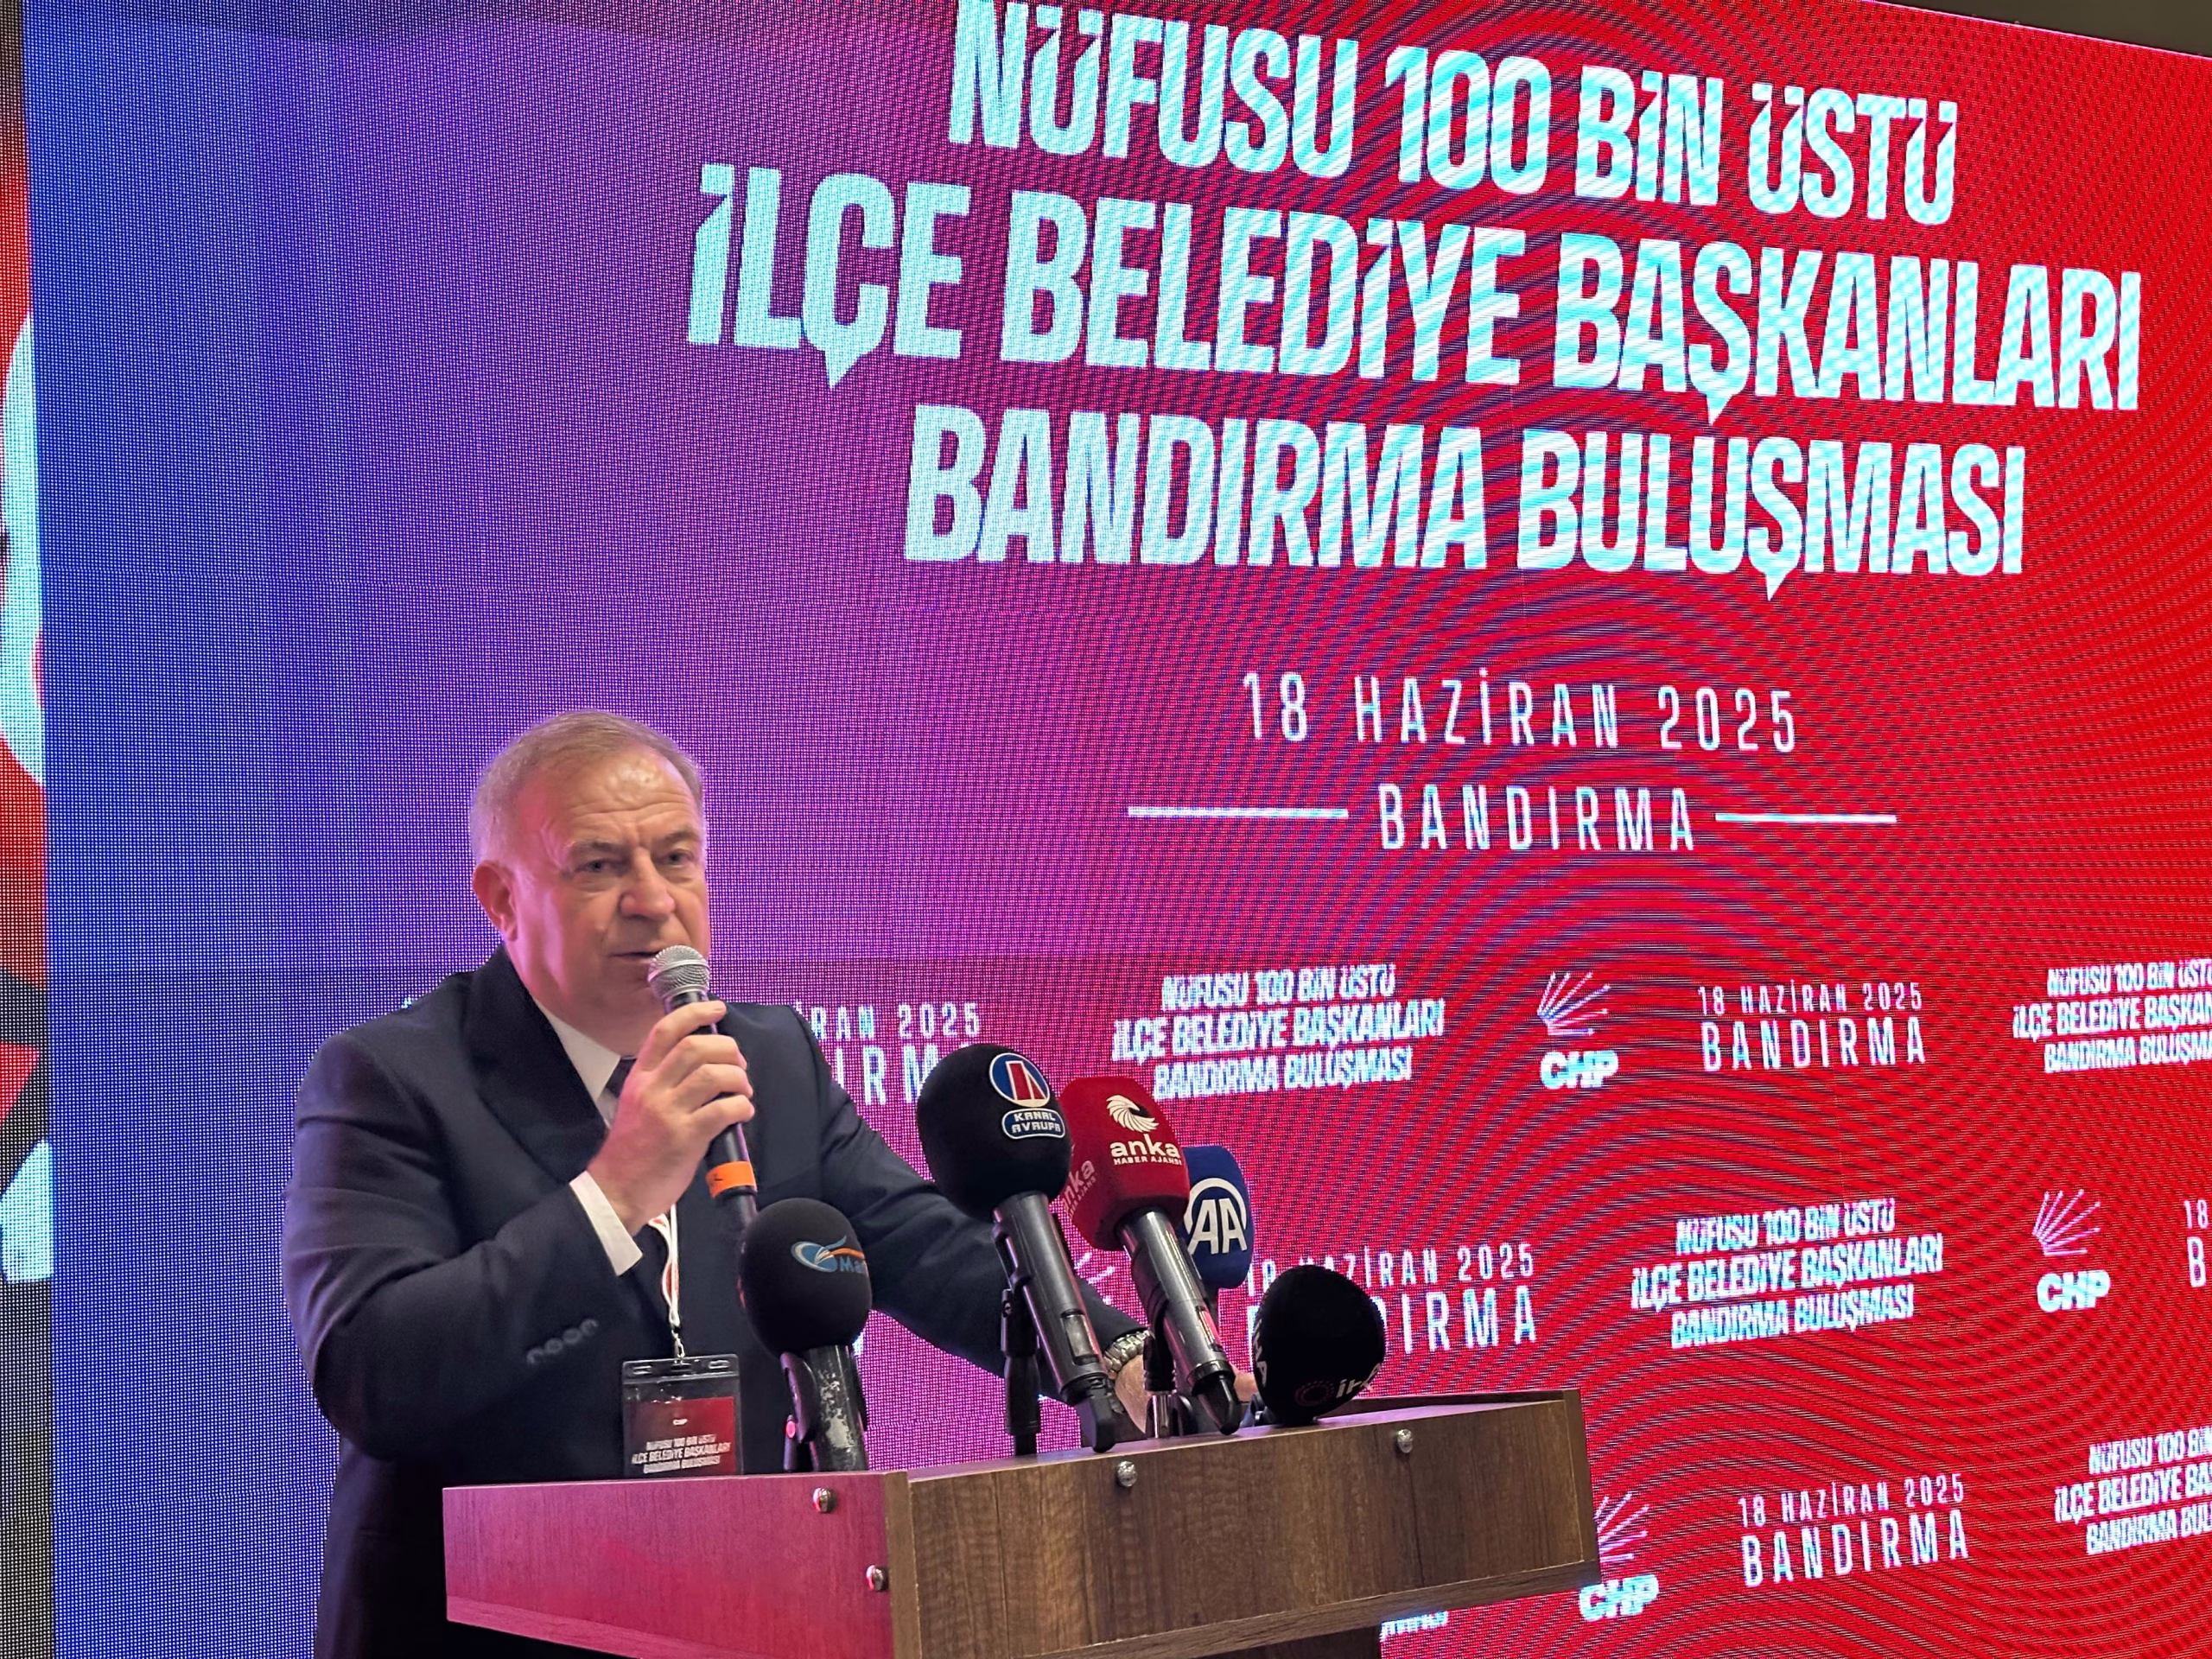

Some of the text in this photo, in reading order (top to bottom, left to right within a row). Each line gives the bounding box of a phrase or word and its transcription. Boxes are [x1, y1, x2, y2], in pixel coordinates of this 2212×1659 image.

[948, 0, 1958, 226] NÜFUSU 100 BİN ÜSTÜ
[687, 163, 2141, 426] İLÇE BELEDİYE BAŞKANLARI
[904, 404, 2024, 601] BANDIRMA BULUŞMASI
[1243, 668, 1796, 753] 18 HAZİRAN 2025
[1378, 783, 1694, 852] BANDIRMA
[1255, 969, 1295, 1005] 100
[2113, 962, 2145, 993] 100
[2146, 961, 2176, 990] BİN
[2177, 957, 2212, 988] ÜST
[1698, 979, 1923, 1015] 18 HAZİRAN 2025
[2056, 997, 2141, 1036] BELEDİYE
[898, 1001, 981, 1039] 2025
[1700, 1016, 1926, 1072] BANDIRMA
[1541, 1049, 1619, 1090] CHP
[1012, 1122, 1061, 1134] AVRUPA
[1014, 1111, 1056, 1122] KANAL
[1109, 1134, 1180, 1158] anka
[1114, 1156, 1148, 1165] HABER
[1187, 1198, 1248, 1255] AA
[1763, 1207, 1801, 1245] 100
[2183, 1198, 2209, 1229] 18
[1457, 1243, 1535, 1281] 2025
[2037, 1269, 2111, 1313] CHP
[2154, 1431, 2185, 1464] 100
[1738, 1472, 1964, 1528] 18 HAZİRAN 2025
[2097, 1466, 2182, 1514] BELEDİYE
[1741, 1509, 1969, 1588] BANDIRMA
[1578, 1573, 1660, 1622] CHP
